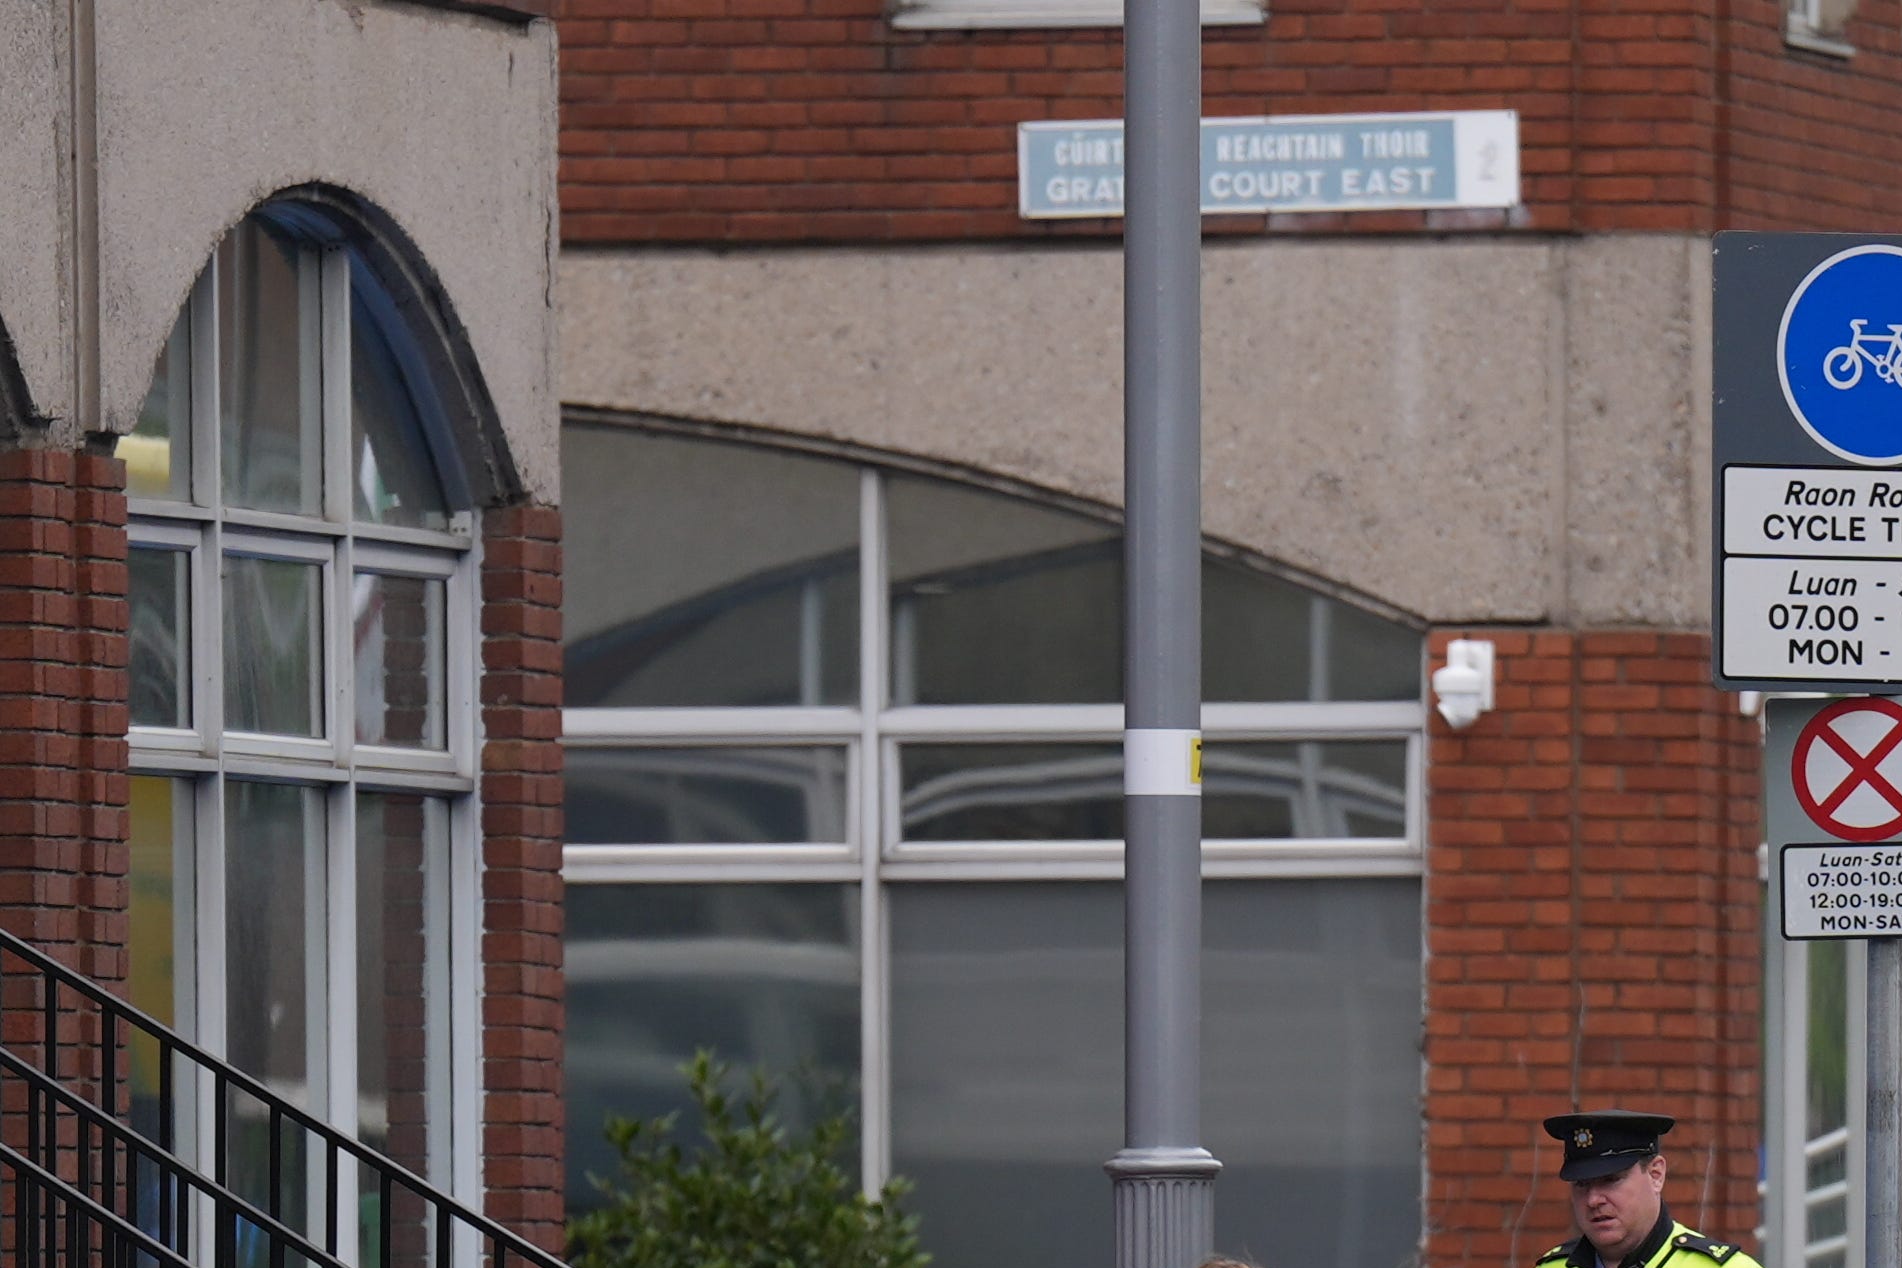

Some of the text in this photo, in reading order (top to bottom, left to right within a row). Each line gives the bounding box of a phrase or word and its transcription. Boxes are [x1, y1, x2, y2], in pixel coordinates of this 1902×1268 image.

[1209, 167, 1322, 200] COURT
[1341, 165, 1435, 197] EAST
[1785, 481, 1855, 507] Raon
[1763, 514, 1865, 541] CYCLE
[1788, 570, 1857, 596] Luan
[1769, 604, 1859, 630] 07.00
[1789, 639, 1863, 665] MON
